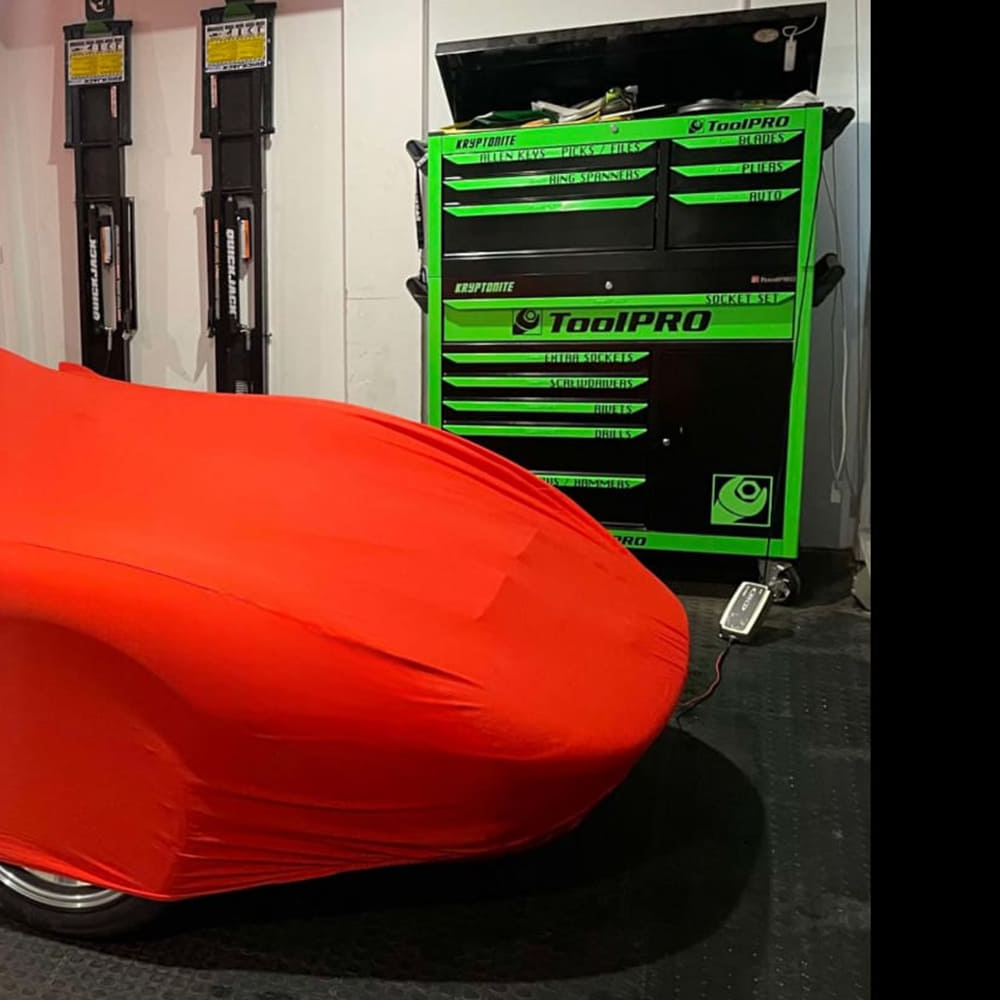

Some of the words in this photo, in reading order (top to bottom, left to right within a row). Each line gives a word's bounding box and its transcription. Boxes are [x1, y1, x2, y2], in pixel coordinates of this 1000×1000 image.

[708, 116, 790, 132] ToolPRO
[456, 135, 517, 149] KRYPTONITE
[738, 133, 785, 145] BLADES
[480, 151, 513, 163] ALLEN
[517, 149, 546, 161] KEYS
[561, 144, 595, 156] PICKS
[611, 142, 641, 154] FILES
[742, 162, 784, 174] PLIERS
[550, 173, 576, 185] RING
[580, 170, 640, 183] SPANNERS
[749, 191, 783, 202] AUTO
[454, 281, 515, 294] KRYPTONITE
[706, 293, 752, 305] SOCKET
[757, 293, 778, 304] SET
[549, 310, 712, 334] ToolPRO
[545, 352, 579, 363] EXTRA
[584, 352, 633, 364] SOCKETS
[550, 378, 633, 389] SCREWDRIVERS
